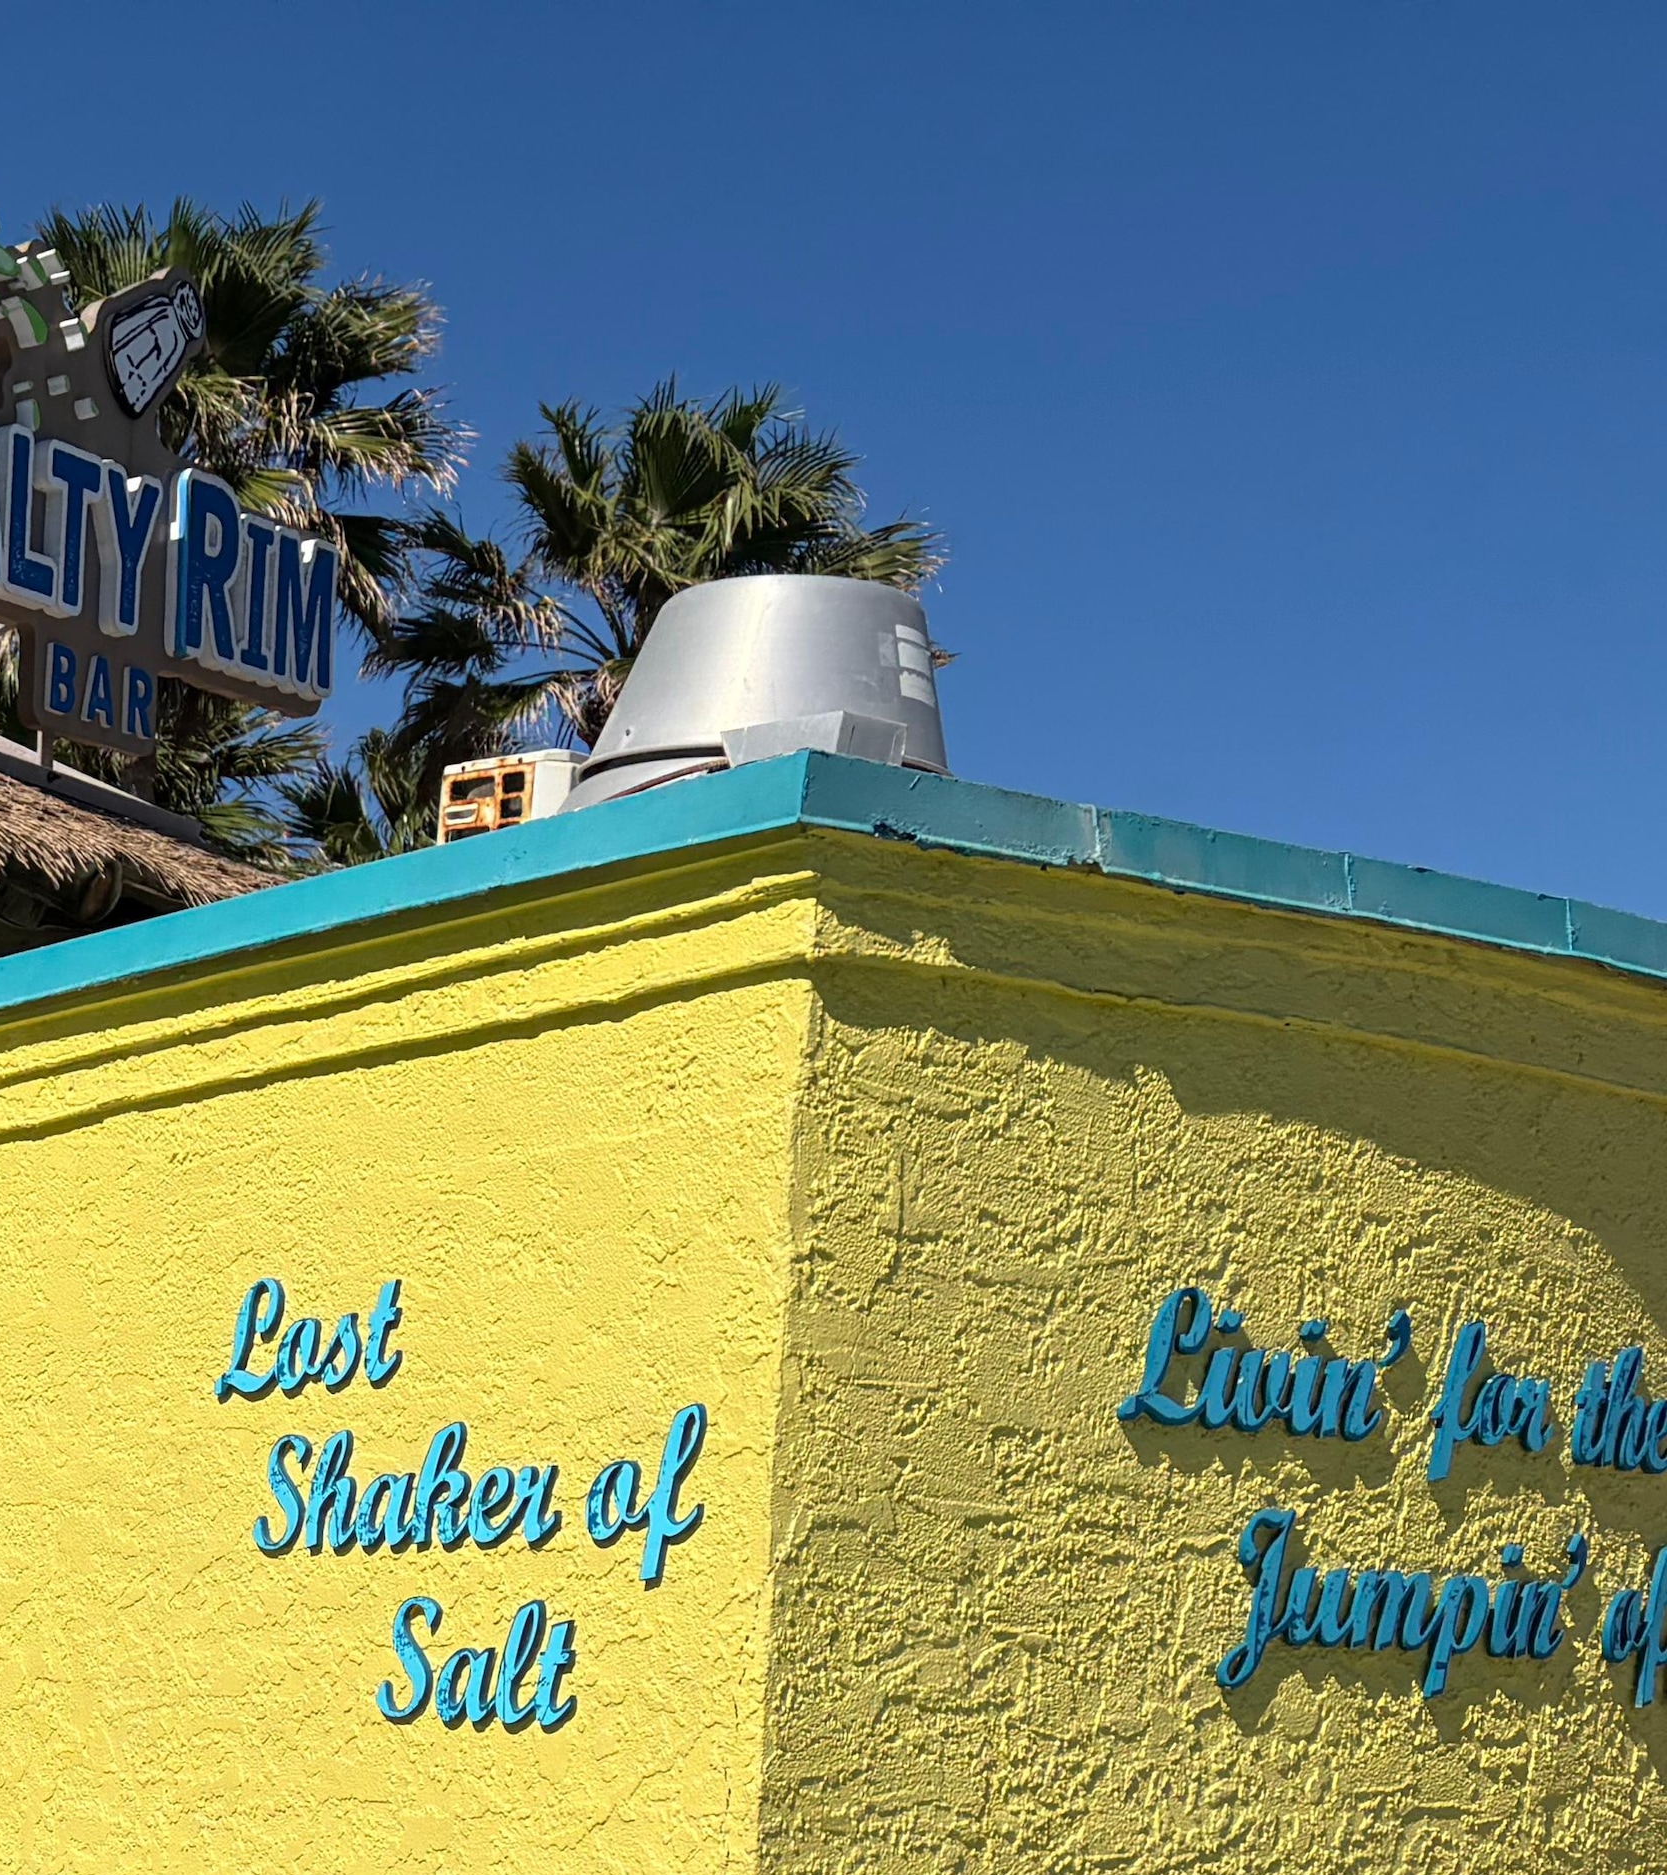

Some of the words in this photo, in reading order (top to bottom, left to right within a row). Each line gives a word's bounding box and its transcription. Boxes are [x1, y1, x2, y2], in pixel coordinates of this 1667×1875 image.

[176, 467, 338, 697] RIM
[49, 641, 155, 739] BAR
[214, 1277, 402, 1401] Lost
[1117, 1286, 1410, 1442] Livin'
[1426, 1320, 1554, 1482] for
[1571, 1346, 1667, 1474] the
[253, 1421, 562, 1557] Shaker
[584, 1403, 708, 1588] of
[375, 1595, 576, 1733] Salt
[1216, 1508, 1587, 1699] Jumpin'
